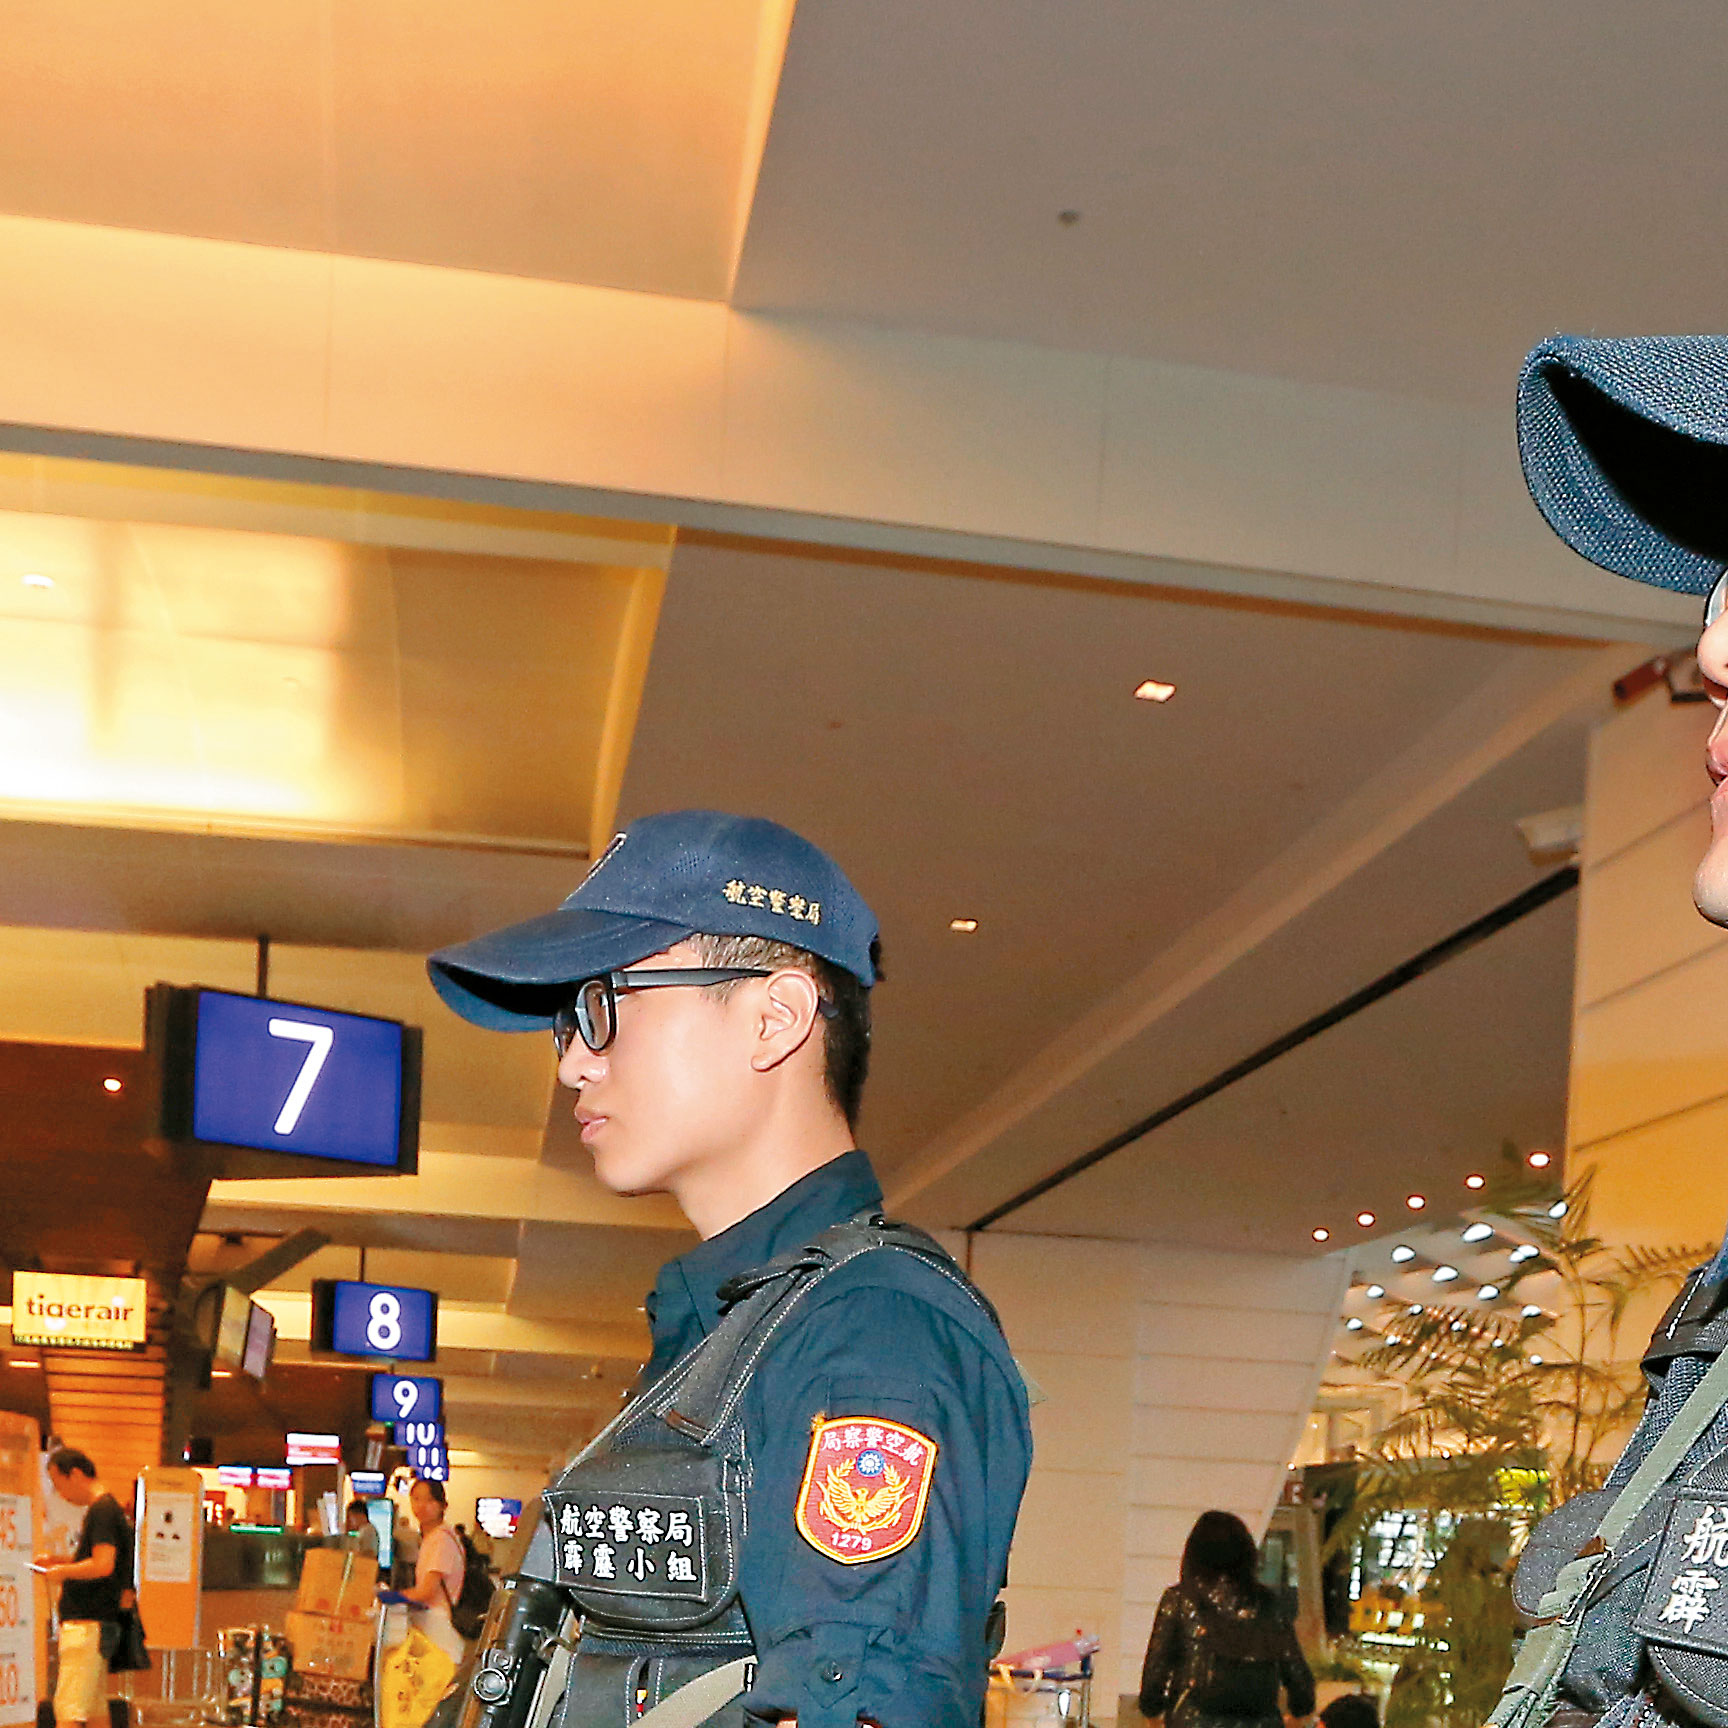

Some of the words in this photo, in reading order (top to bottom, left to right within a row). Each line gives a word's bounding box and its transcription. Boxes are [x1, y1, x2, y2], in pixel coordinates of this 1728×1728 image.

[268, 1018, 334, 1135] 7
[27, 1294, 134, 1323] tigerair
[367, 1292, 401, 1350] 8
[392, 1380, 419, 1418] 9
[560, 1503, 694, 1547] 航空警察局
[831, 1531, 872, 1551] 1279
[563, 1540, 697, 1581] 霹靂小組
